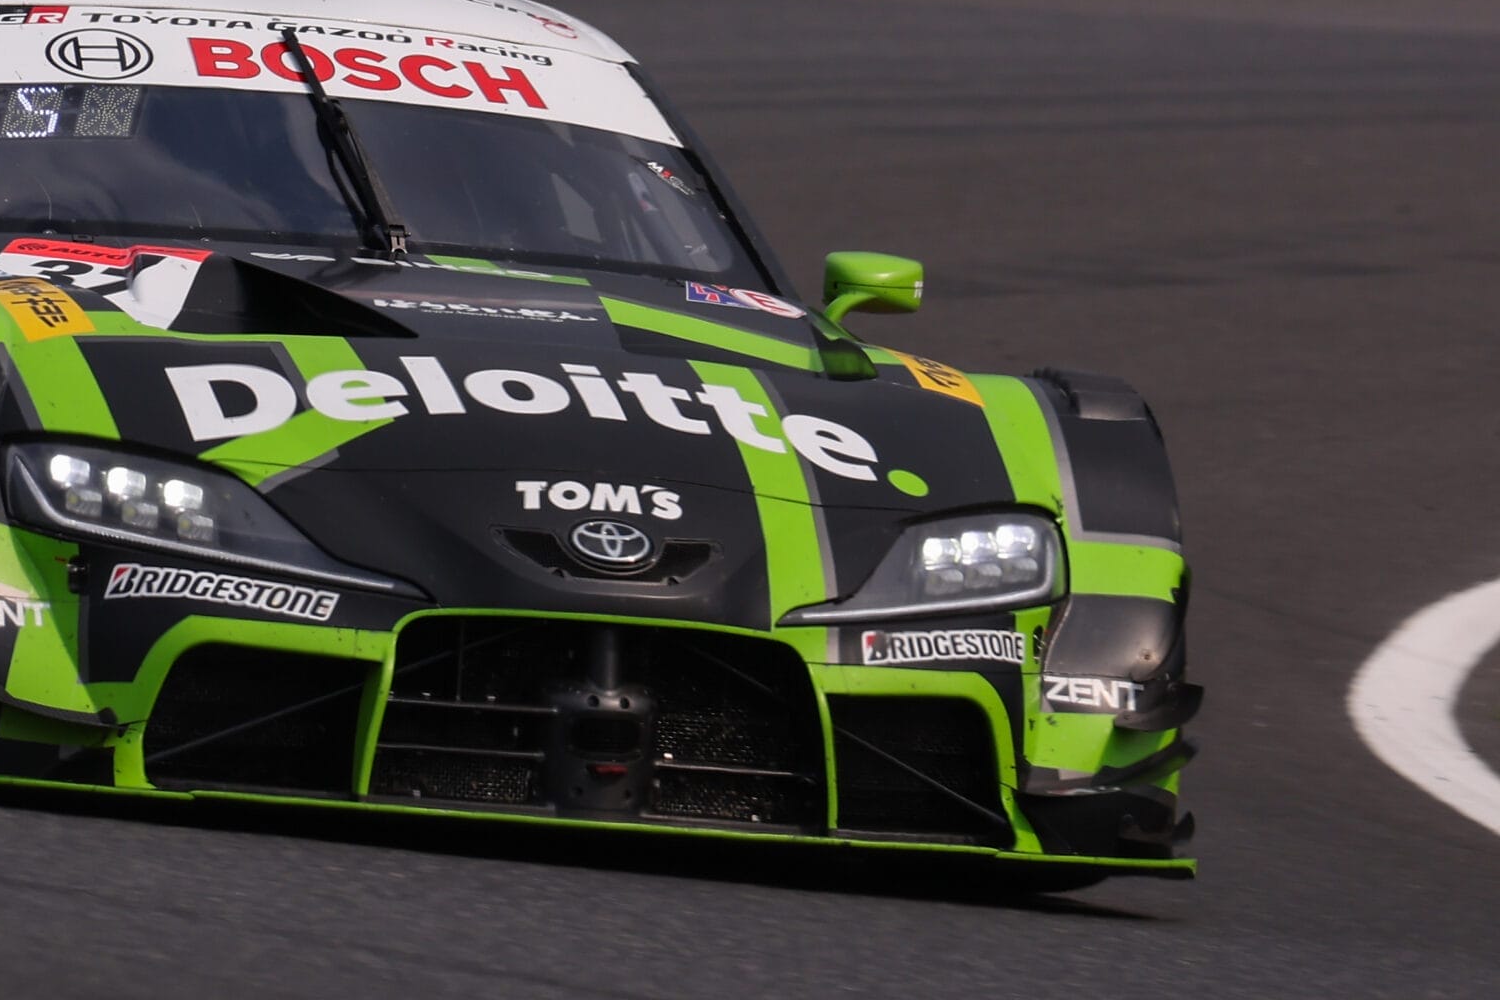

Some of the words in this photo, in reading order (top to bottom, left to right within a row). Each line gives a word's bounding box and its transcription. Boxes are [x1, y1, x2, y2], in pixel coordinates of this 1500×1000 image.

[80, 11, 254, 31] TOYOTA
[266, 19, 412, 44] GAZOO
[424, 35, 553, 67] Racing
[187, 35, 549, 111] BOSCH
[514, 479, 684, 522] TOM'S
[107, 564, 338, 620] BRIDGESTONE
[863, 630, 1026, 665] BRIDGESTONE
[1042, 675, 1145, 713] ZENT
